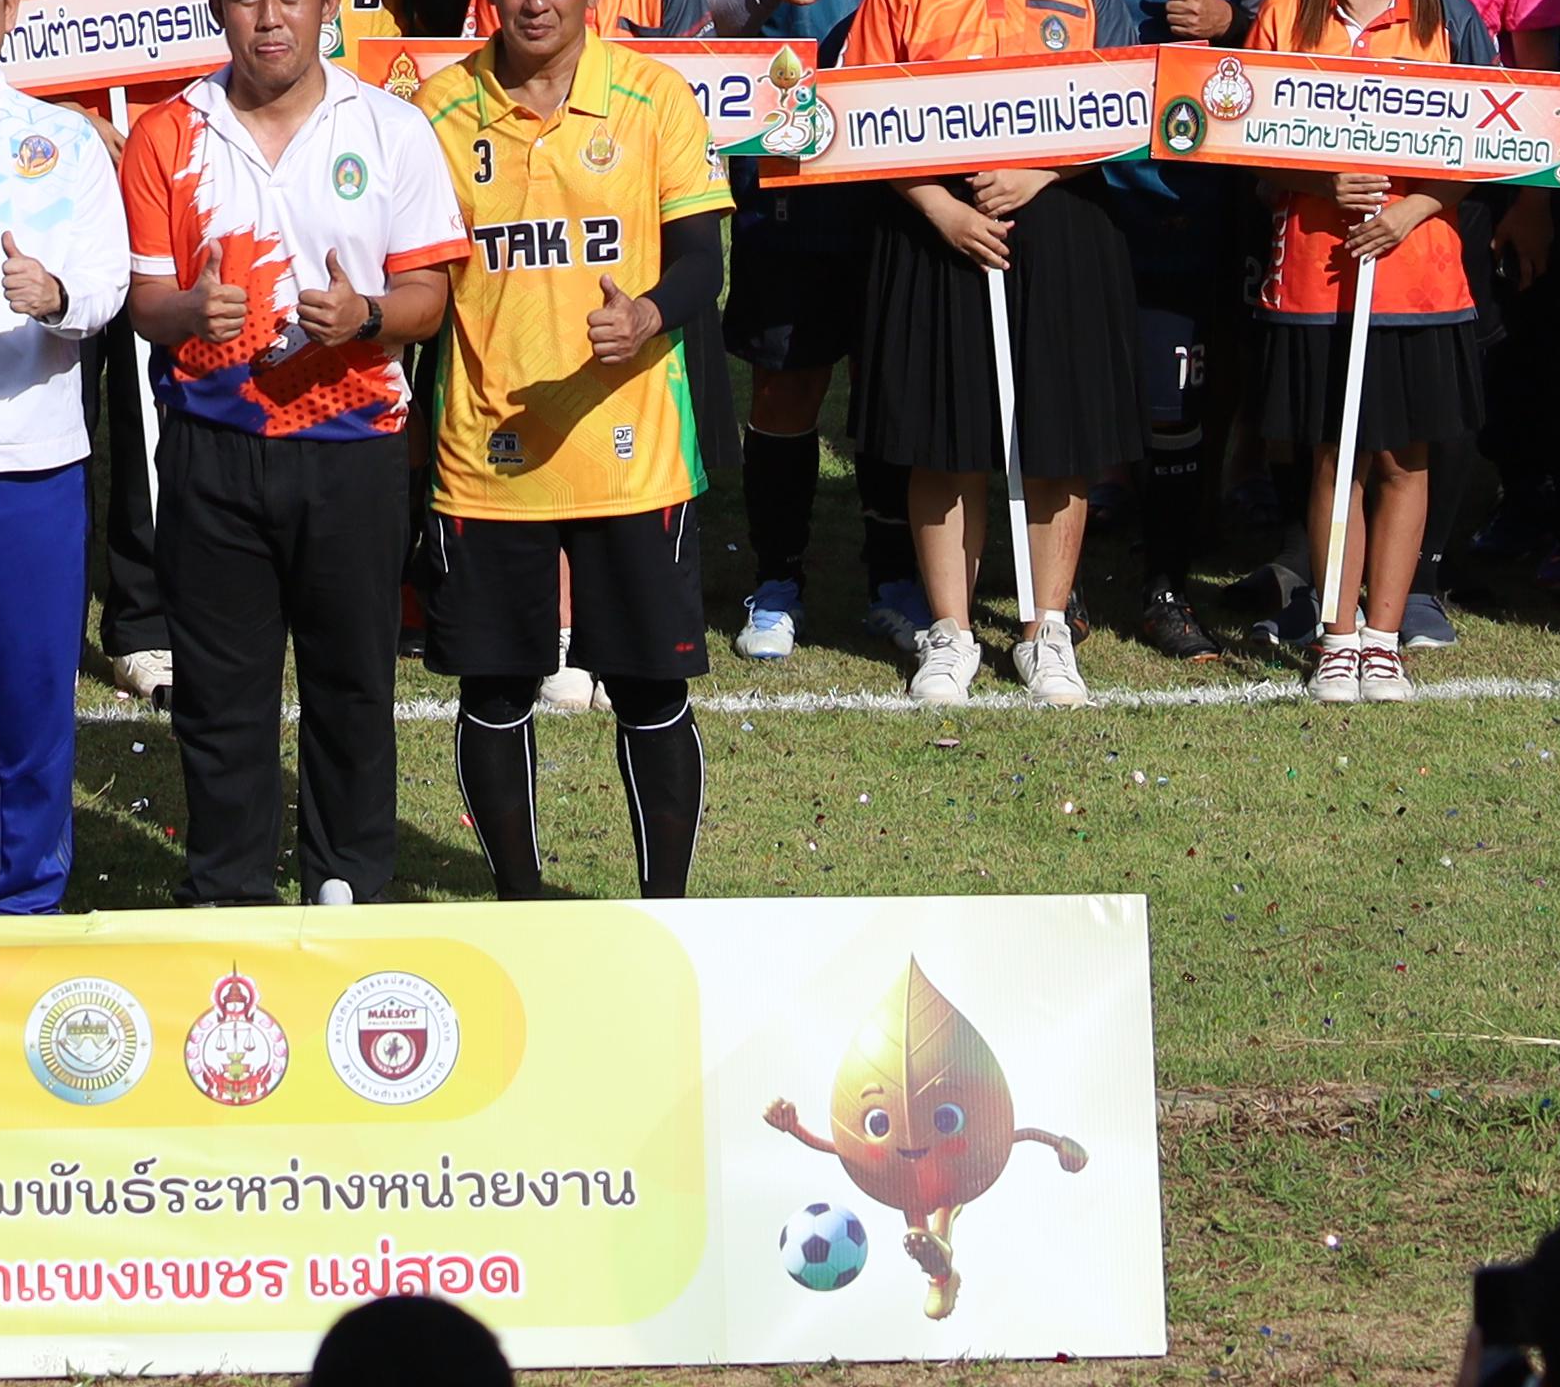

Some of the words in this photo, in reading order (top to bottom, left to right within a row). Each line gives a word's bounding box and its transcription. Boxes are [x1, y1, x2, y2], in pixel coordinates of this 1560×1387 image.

[847, 83, 1150, 149] เทศบาลนครแม่สอด
[1273, 77, 1469, 120] ศาลยุติธรรม
[473, 138, 494, 184] 3
[1244, 118, 1464, 168] มหาวิทยาลัยราชภัฏ
[1473, 132, 1552, 165] แม่สอด
[473, 218, 574, 273] TAK
[582, 214, 623, 266] 2
[367, 1008, 418, 1020] MAESOT
[306, 1240, 523, 1299] แม่สอด
